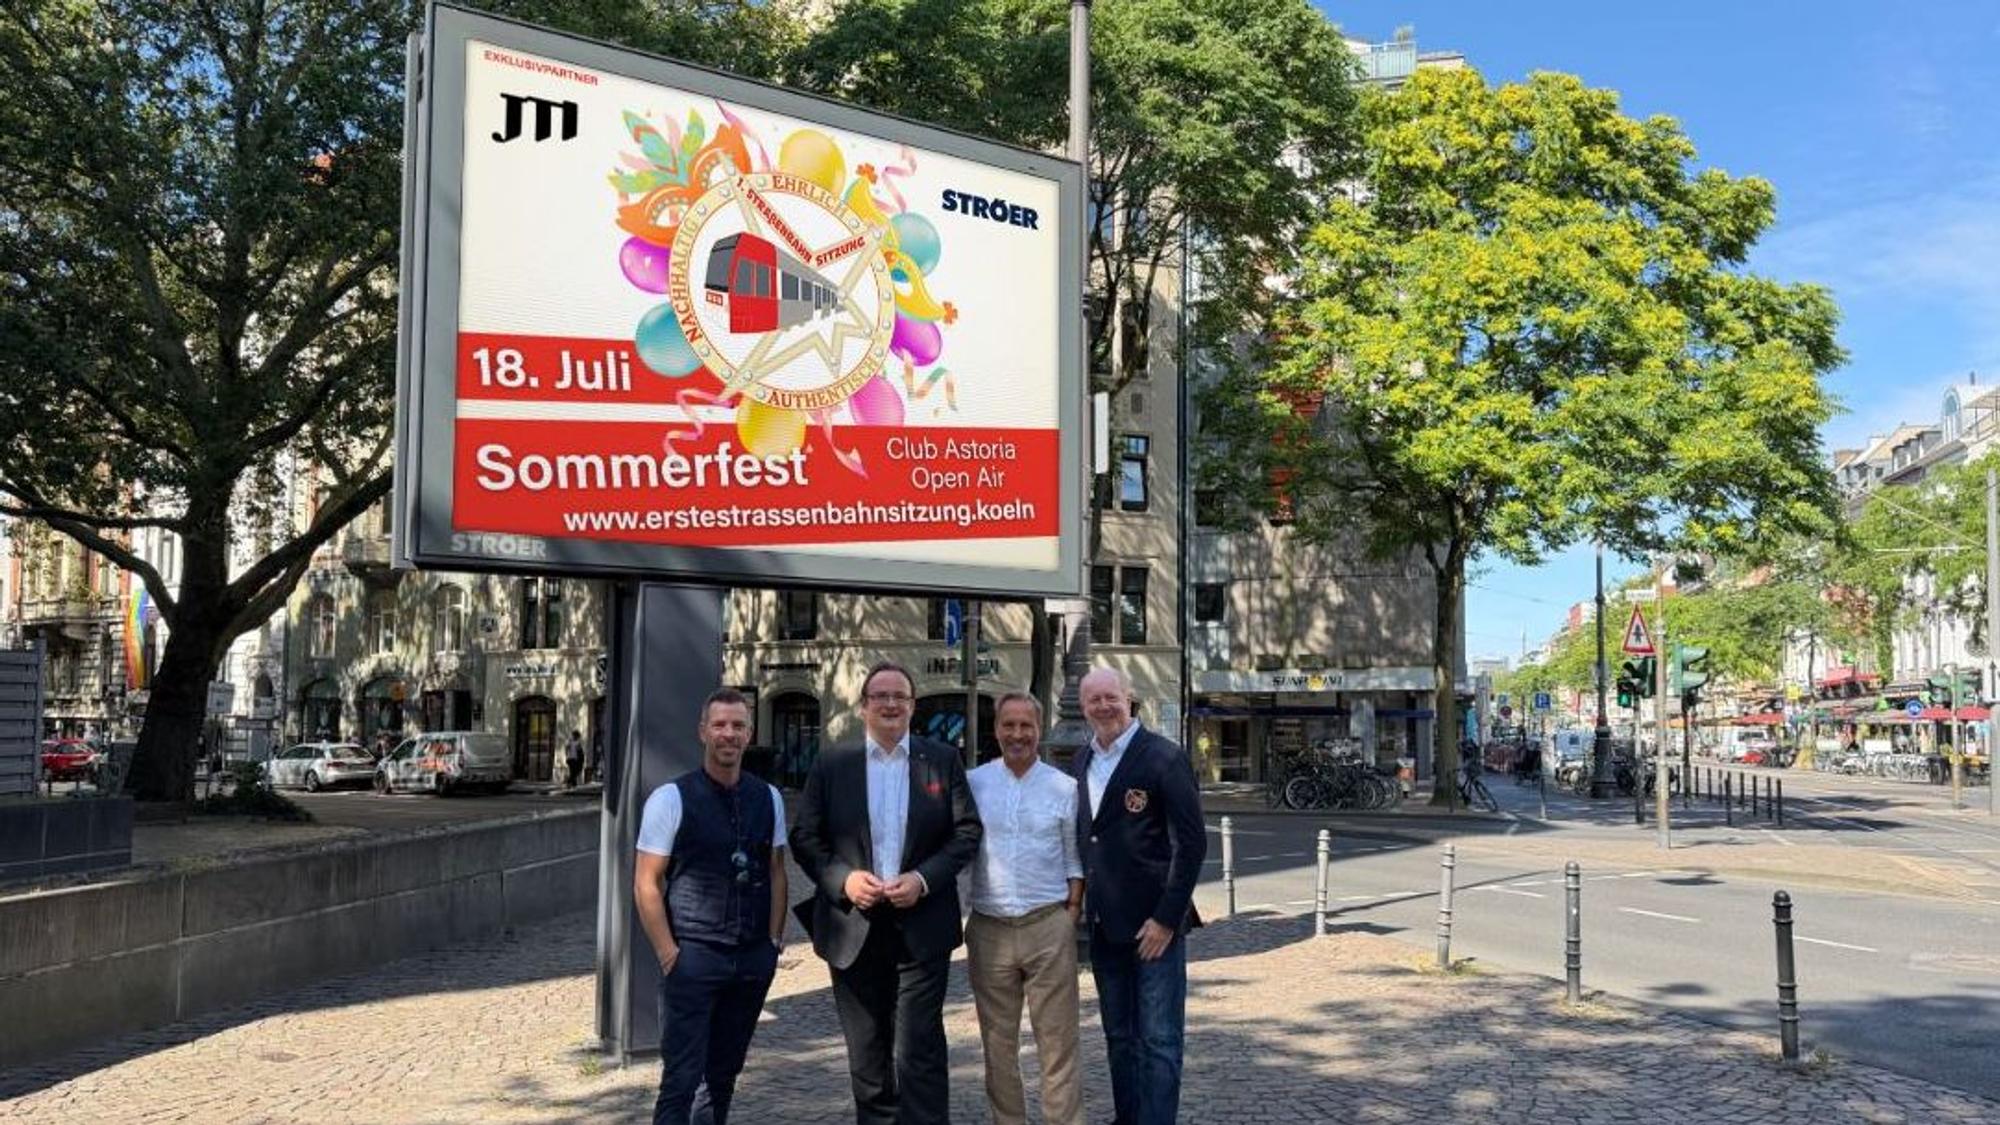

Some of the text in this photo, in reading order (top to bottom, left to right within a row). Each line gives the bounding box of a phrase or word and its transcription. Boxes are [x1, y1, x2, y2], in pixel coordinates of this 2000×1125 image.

[484, 50, 599, 86] EXKLUSIVPARTNER
[772, 175, 847, 217] EHRLICH
[941, 188, 1039, 230] STRÖER
[815, 236, 866, 267] SITZUNG
[671, 217, 703, 343] NACHHALTIG
[472, 347, 633, 391] 18. Juli
[767, 358, 879, 408] AUTHENTISCH
[476, 441, 809, 491] Sommerfest
[887, 437, 1016, 460] Club Astoria
[911, 467, 1005, 493] Open Air
[563, 499, 1036, 532] www.erstestrassenbahnsitzung.koeln
